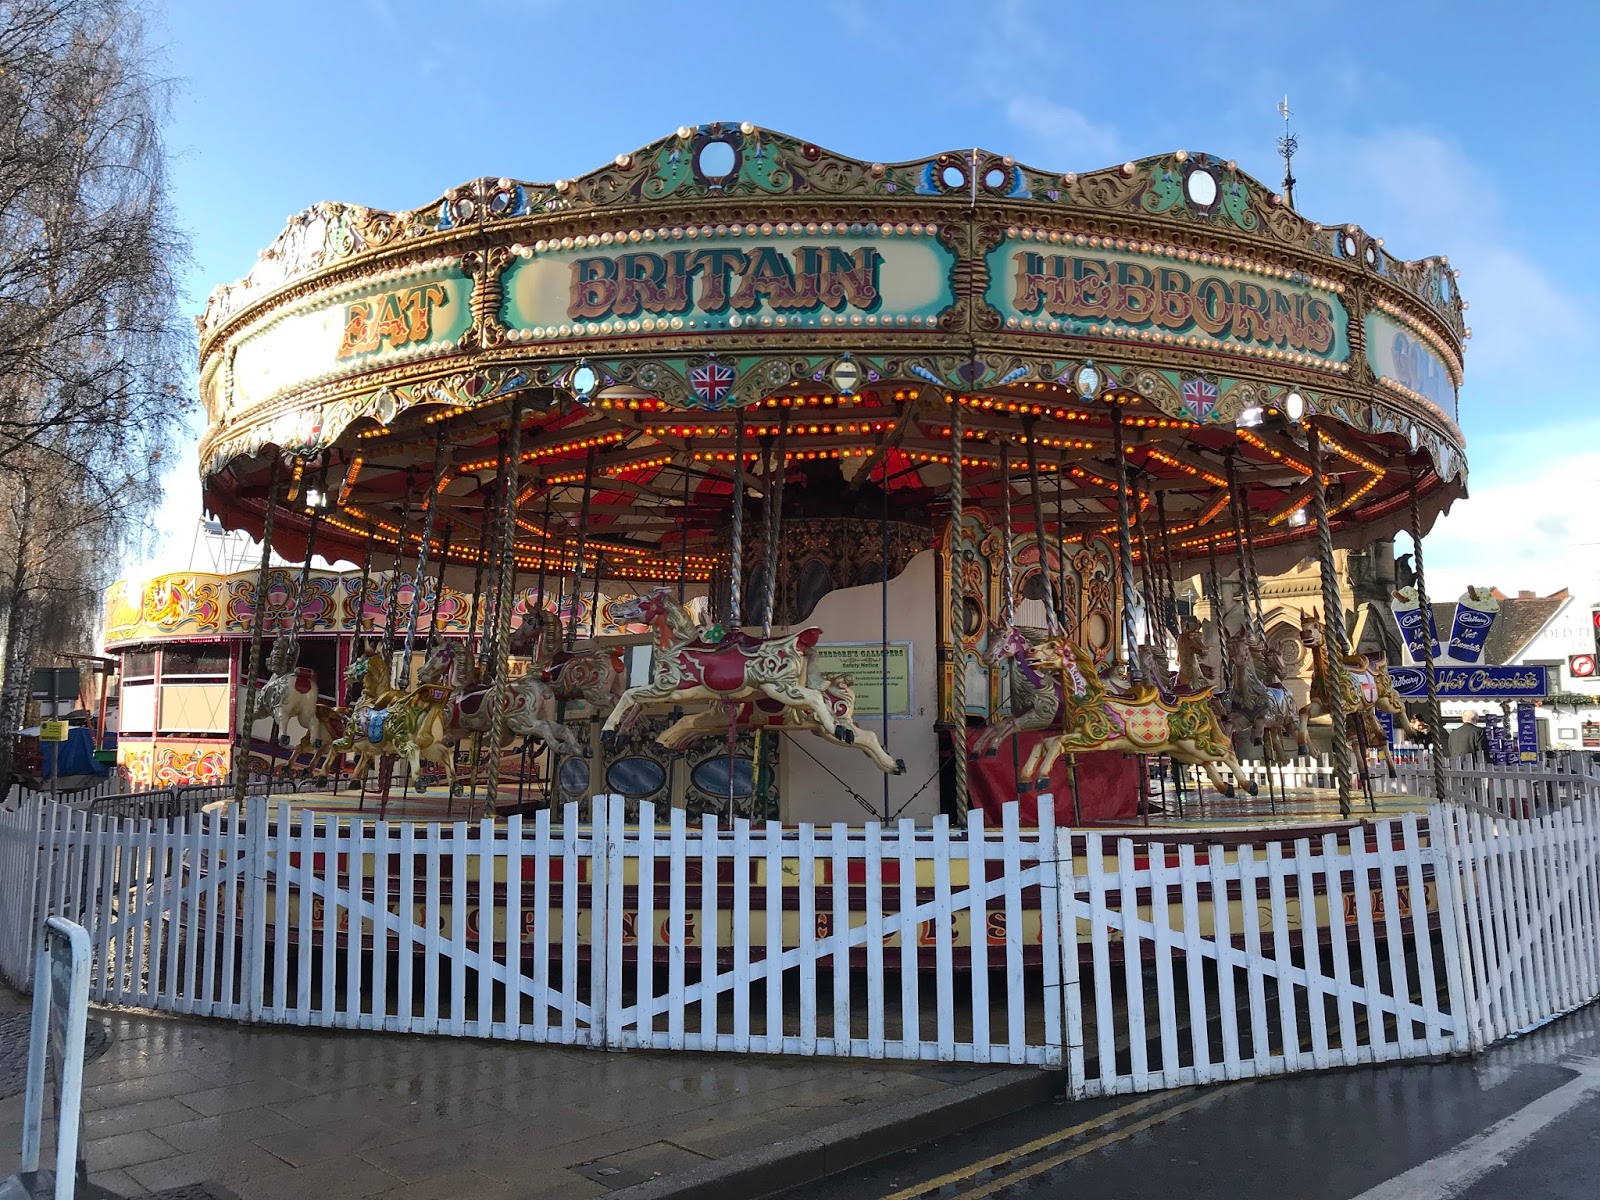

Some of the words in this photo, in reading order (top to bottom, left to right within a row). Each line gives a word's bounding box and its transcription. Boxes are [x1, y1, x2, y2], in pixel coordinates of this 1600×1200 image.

[567, 246, 884, 322] BRITAIN
[1459, 612, 1488, 624] Cadbury
[1461, 628, 1478, 638] Hot
[1544, 628, 1572, 638] OLD
[1450, 637, 1481, 652] Chocolate
[1436, 669, 1468, 693] Hot
[1468, 669, 1540, 693] Chocolate
